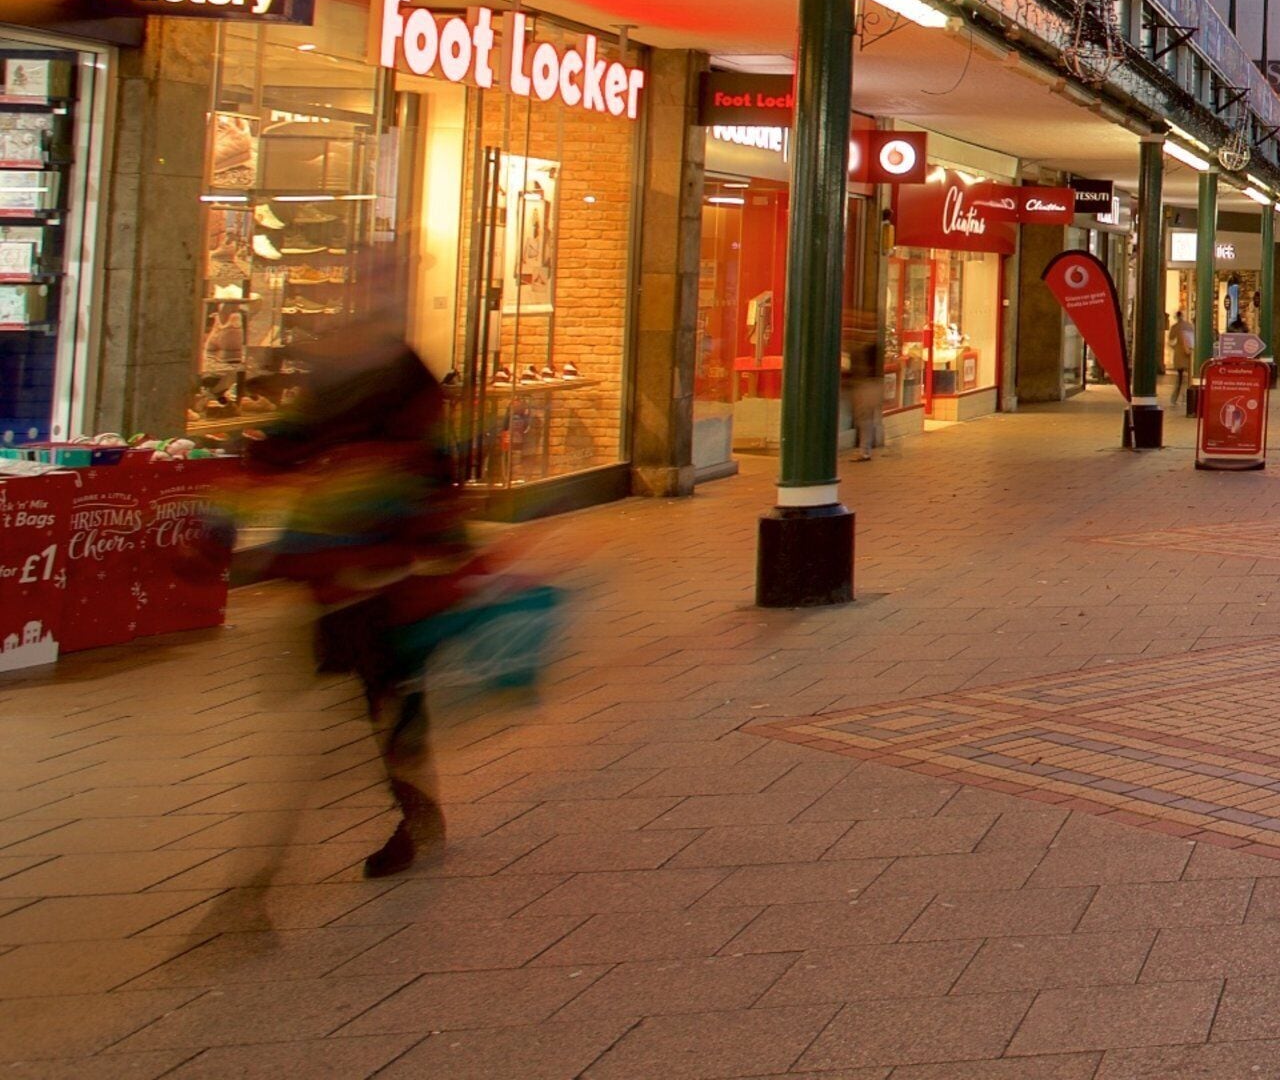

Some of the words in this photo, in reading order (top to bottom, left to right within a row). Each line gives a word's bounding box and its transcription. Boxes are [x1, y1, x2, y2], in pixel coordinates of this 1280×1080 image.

[510, 12, 644, 119] Locker
[714, 91, 752, 107] Foot
[943, 185, 986, 236] Clintons
[1075, 192, 1110, 201] TESSUTI
[15, 511, 56, 529] Bags
[19, 543, 58, 584] £1
